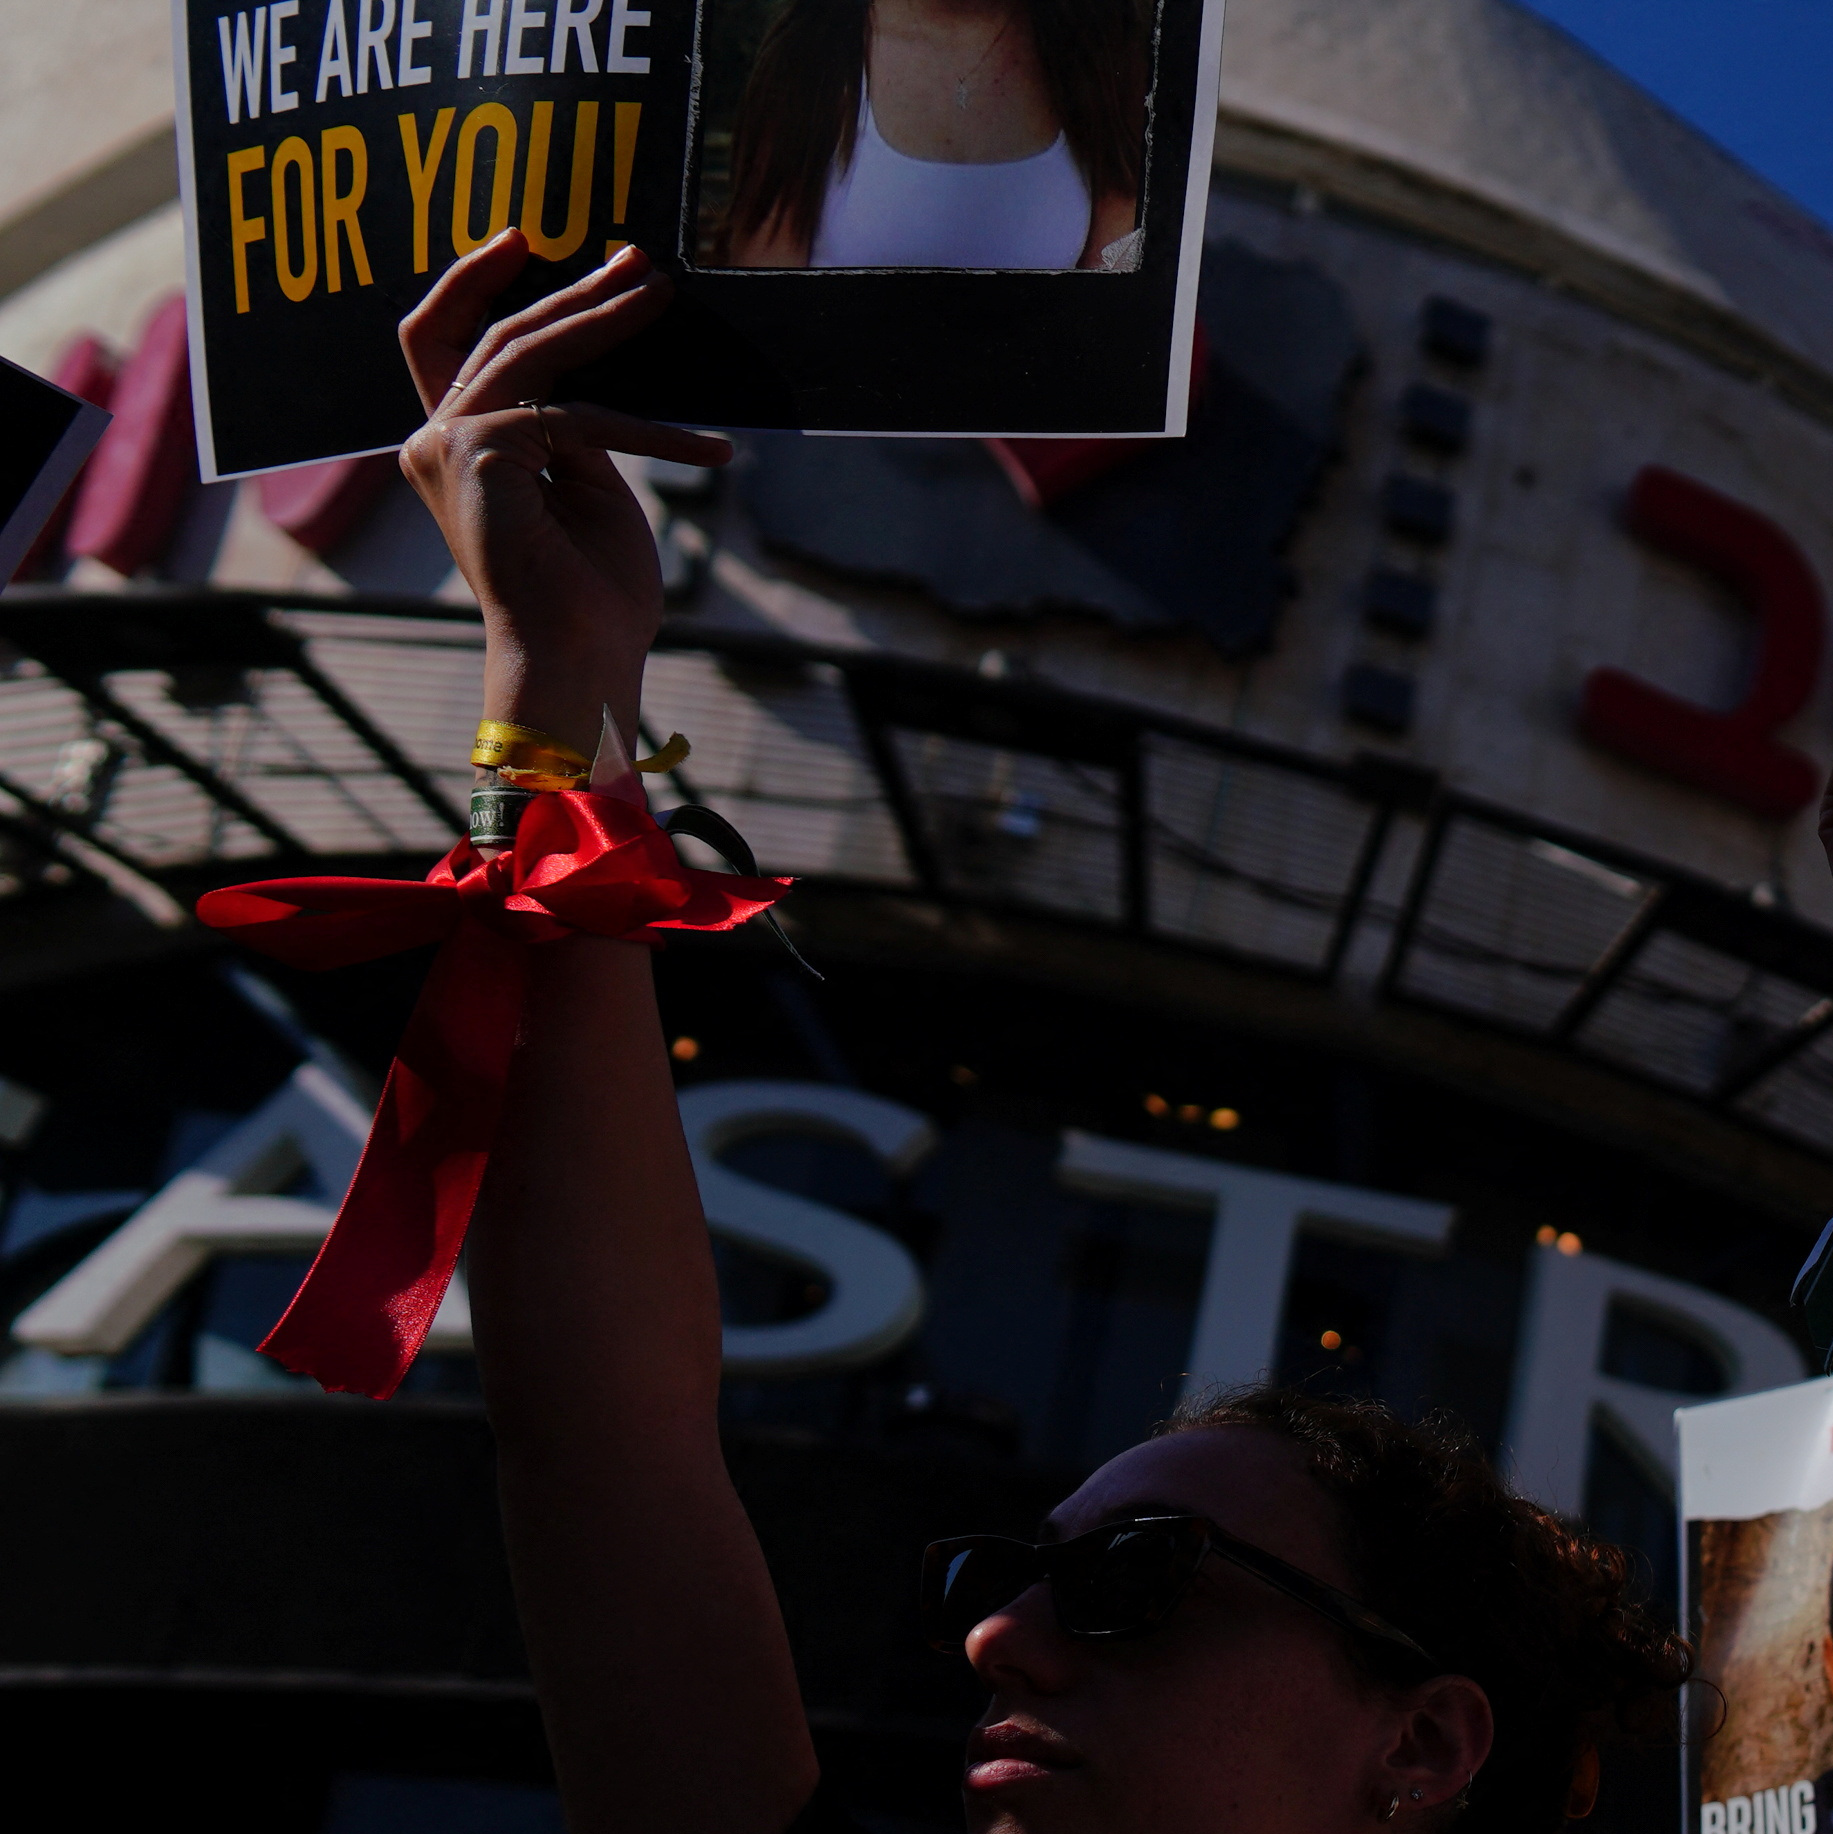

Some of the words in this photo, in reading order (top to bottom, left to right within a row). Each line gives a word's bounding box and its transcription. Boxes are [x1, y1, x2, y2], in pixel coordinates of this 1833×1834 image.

[217, 0, 299, 125] WE
[315, 0, 433, 104] ARE
[226, 125, 374, 314] FOR
[397, 101, 643, 274] YOU!
[474, 738, 503, 753] ome
